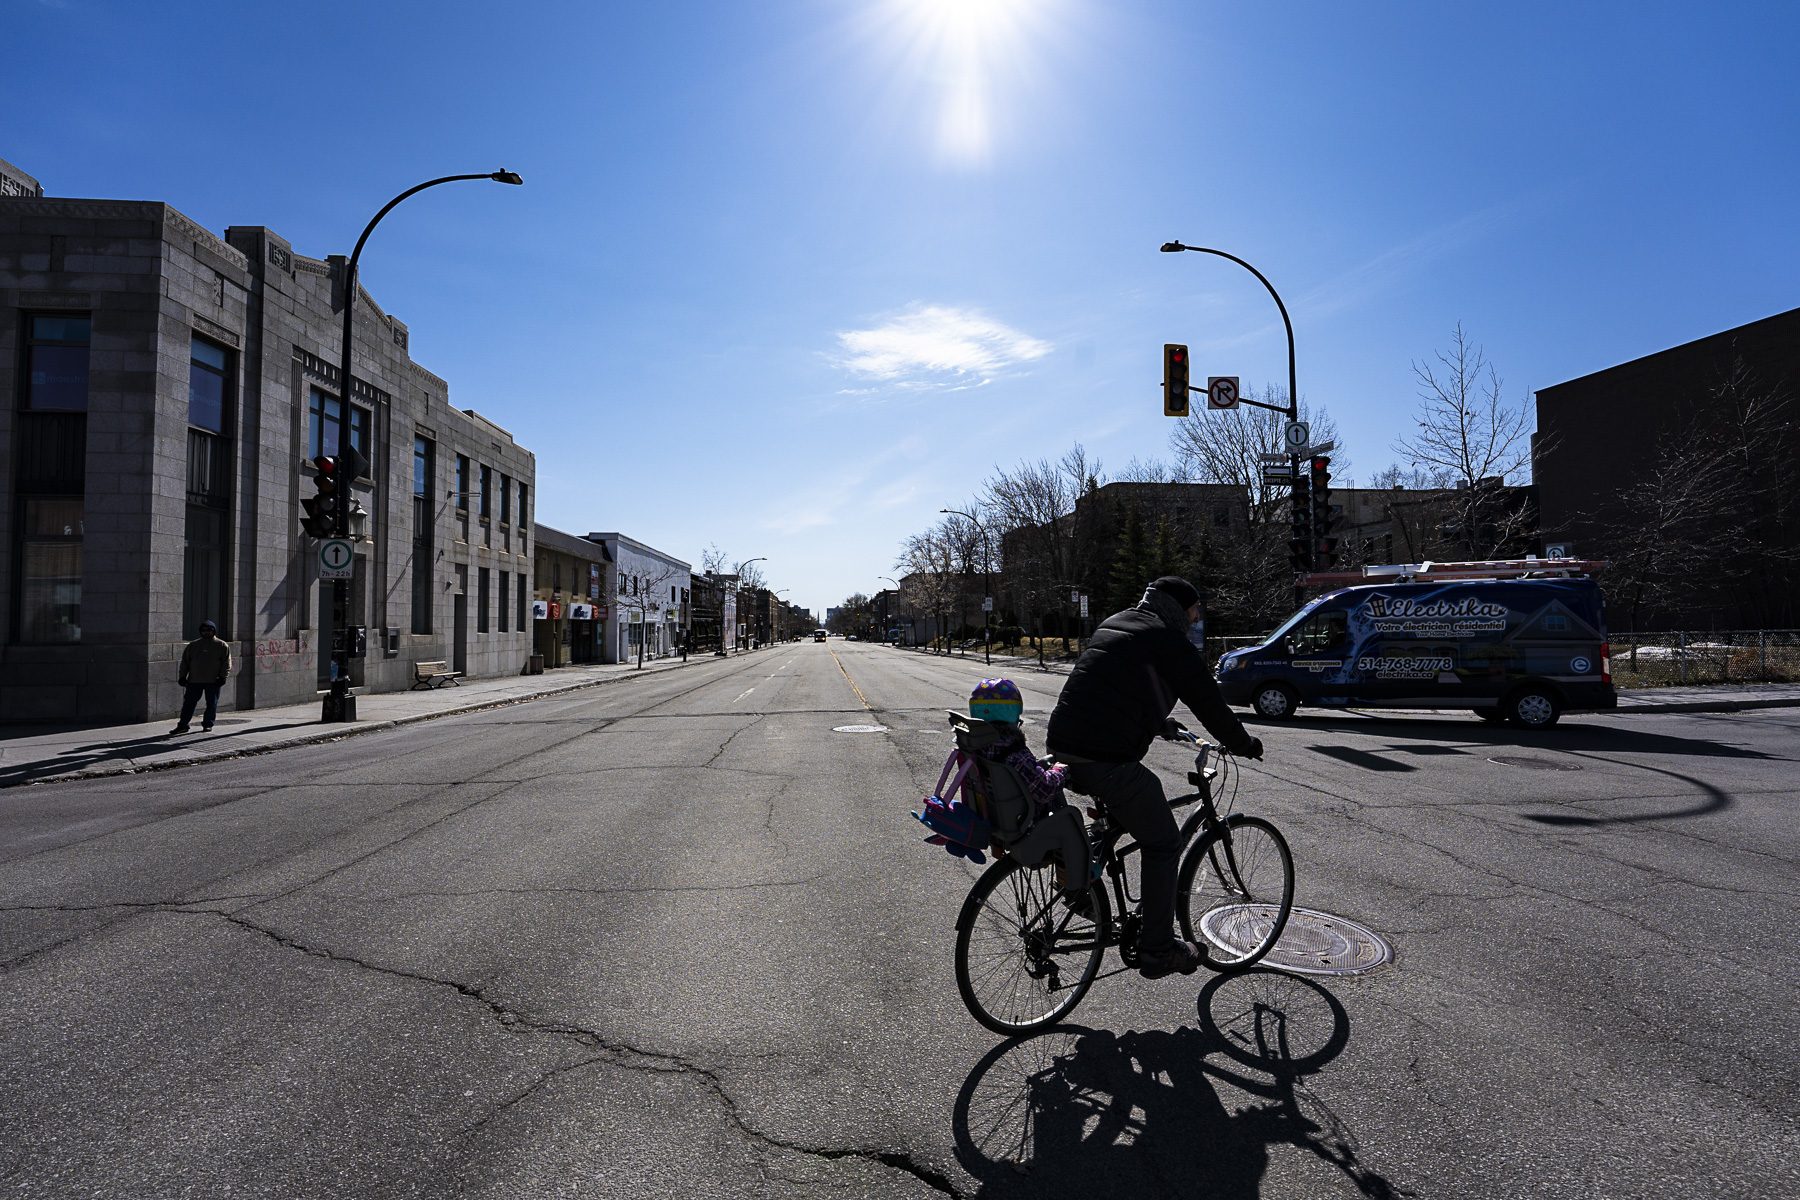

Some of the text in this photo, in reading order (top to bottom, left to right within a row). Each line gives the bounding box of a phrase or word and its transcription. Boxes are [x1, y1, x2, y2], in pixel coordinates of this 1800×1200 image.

[1376, 620, 1505, 631] Votre électricien résidentiel
[1358, 658, 1452, 670] 514-768-7778
[1376, 670, 1434, 679] electrika.ca
